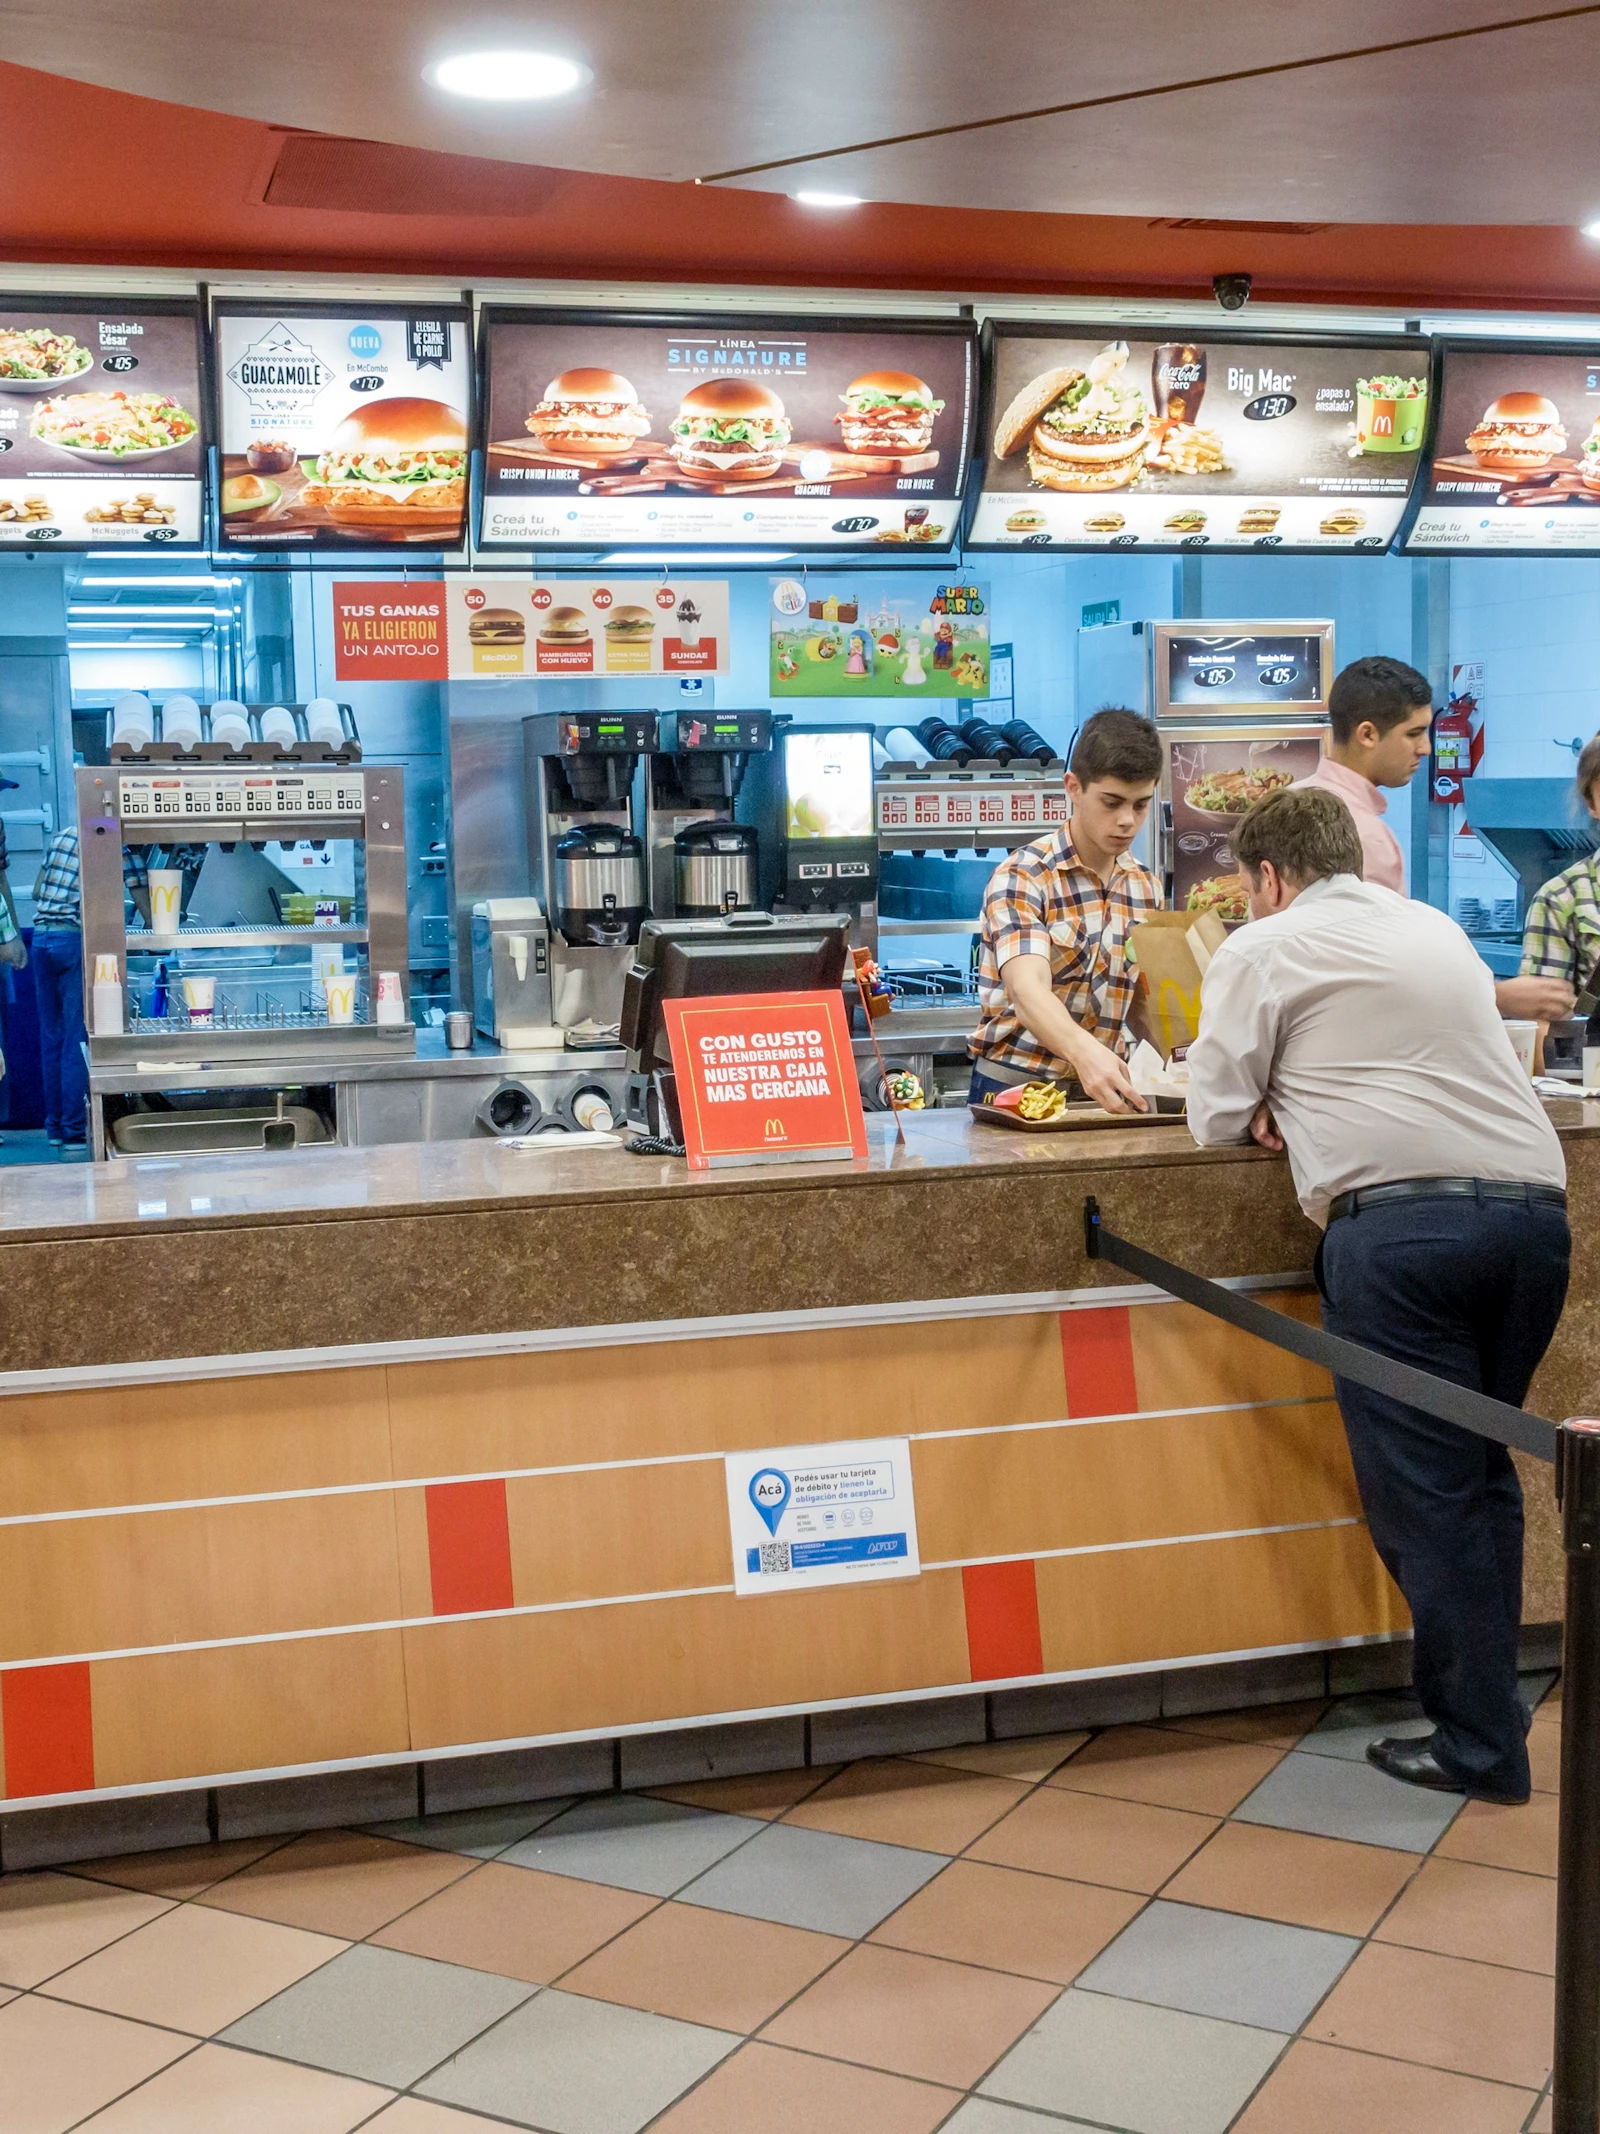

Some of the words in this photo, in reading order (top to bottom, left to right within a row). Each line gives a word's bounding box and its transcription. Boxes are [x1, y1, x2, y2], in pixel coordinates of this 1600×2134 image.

[99, 322, 144, 335] Ensalada
[99, 333, 128, 346] César
[350, 336, 380, 349] NUEVA
[413, 333, 422, 344] DE
[423, 333, 444, 345] CARNE
[720, 338, 756, 349] LÍNEA
[422, 345, 443, 357] POLLO
[667, 348, 807, 366] SIGNATURE
[241, 363, 321, 386] GUACAMOLE
[347, 364, 356, 373] En
[357, 364, 389, 373] McCombo
[712, 367, 782, 375] McDONALD'S
[1169, 381, 1190, 390] zero
[1227, 367, 1254, 397] Big
[1258, 367, 1292, 392] Mac
[1315, 388, 1344, 401] ¿papas
[1345, 390, 1350, 399] o
[1315, 400, 1354, 413] ensalada?
[250, 418, 314, 426] SIGNATURE
[500, 468, 525, 480] CRISPY
[525, 468, 546, 480] ONION
[546, 468, 580, 480] BARBECUE
[794, 484, 832, 496] GUACAMOLE
[896, 478, 912, 490] CLUB
[913, 478, 934, 490] HOUSE
[1436, 481, 1456, 492] CRISPY
[1456, 482, 1474, 492] ONION
[988, 496, 996, 504] En
[492, 513, 526, 524] Creá
[531, 514, 545, 524] tu
[92, 527, 139, 536] McNuggets
[490, 525, 561, 537] Sándwich
[1418, 522, 1445, 532] Creá
[1449, 522, 1461, 532] tu
[1413, 533, 1470, 543] Sándwich
[936, 585, 979, 599] SUPER
[466, 595, 484, 605] 50
[533, 595, 550, 604] 40
[594, 595, 611, 604] 40
[657, 595, 674, 604] 35
[341, 605, 376, 617] TUS
[379, 604, 440, 617] GANAS
[929, 597, 985, 615] MARIO
[1083, 612, 1105, 627] SALIDA
[343, 621, 360, 640] YA
[365, 620, 437, 640] ELIGIERON
[343, 644, 368, 657] UN
[373, 644, 439, 656] ANTOJO
[481, 652, 518, 662] McDÚO
[700, 1034, 746, 1051] CON
[750, 1030, 822, 1048] GUSTO
[701, 1052, 717, 1065] TE
[720, 1048, 806, 1064] ATENDEREMOS
[808, 1047, 824, 1058] EN
[704, 1065, 781, 1083] NUESTRA
[785, 1061, 828, 1078] CAJA
[706, 1084, 747, 1103] MAS
[751, 1078, 831, 1100] CERCANA
[794, 1474, 819, 1483] Podés
[820, 1473, 838, 1481] usar
[840, 1471, 848, 1479] tu
[850, 1468, 876, 1479] tarjeta
[758, 1482, 782, 1496] Acá
[795, 1484, 805, 1493] de
[807, 1482, 832, 1492] débito
[834, 1483, 838, 1491] y
[840, 1480, 865, 1489] tienen
[866, 1479, 874, 1487] la
[796, 1492, 837, 1504] obligación
[838, 1491, 848, 1499] de
[850, 1487, 888, 1499] aceptarla
